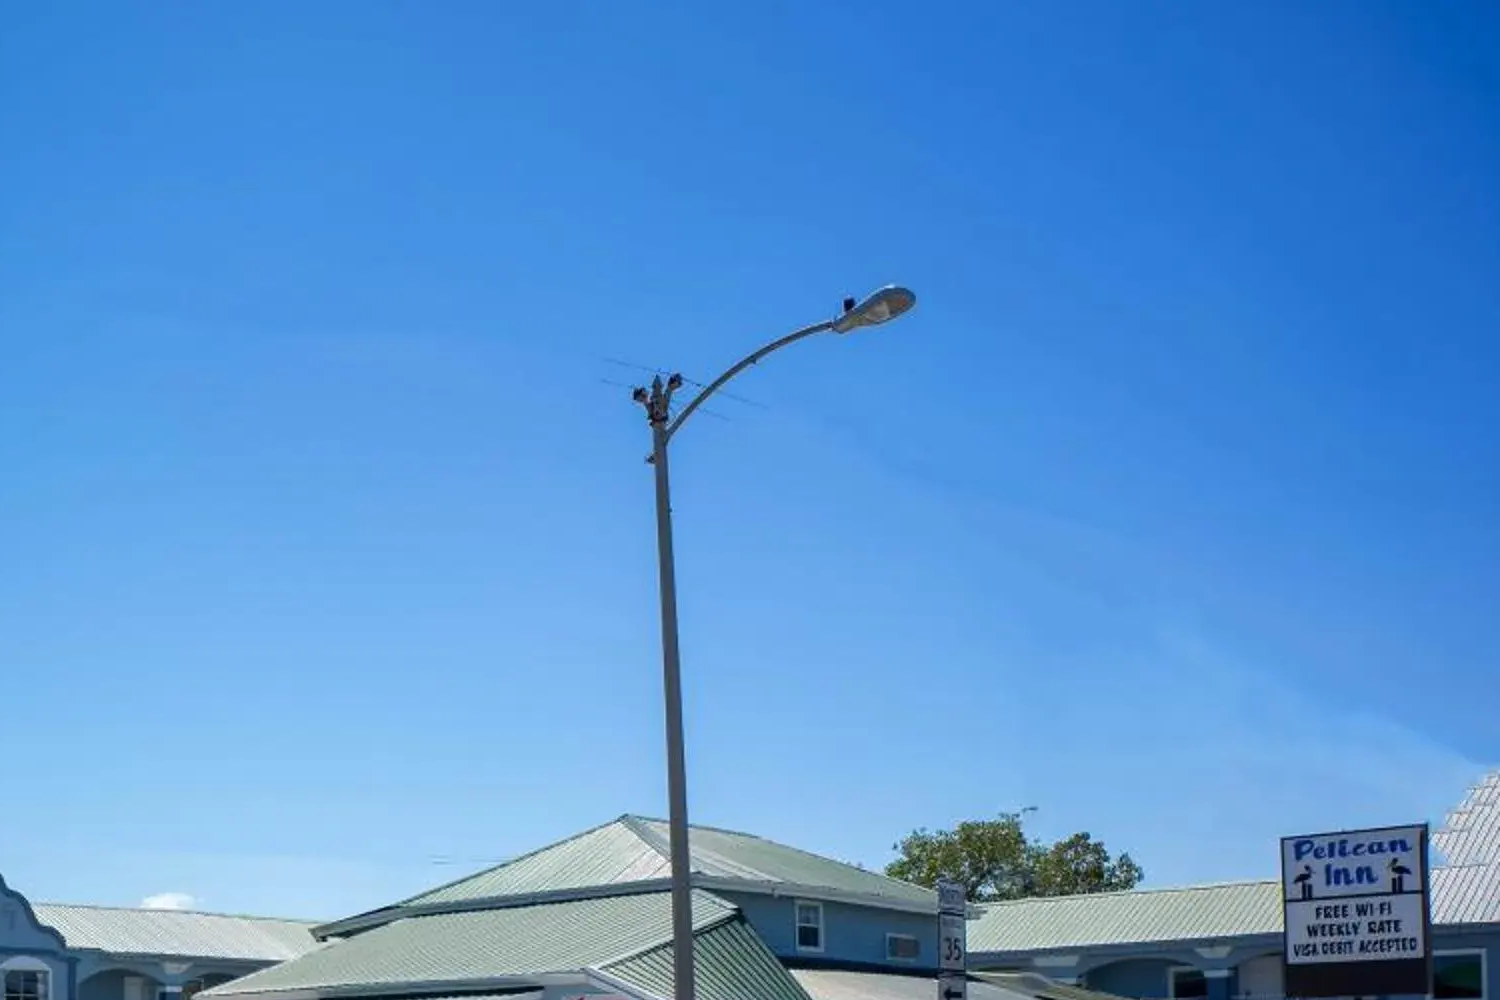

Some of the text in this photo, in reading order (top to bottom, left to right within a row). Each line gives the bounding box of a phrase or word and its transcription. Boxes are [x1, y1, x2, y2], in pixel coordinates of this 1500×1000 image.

[1294, 839, 1412, 861] Pelican
[1324, 863, 1379, 886] Inn
[1315, 904, 1349, 920] FREE
[1306, 919, 1402, 937] WEEKLY RATE
[943, 937, 962, 960] 35
[1359, 937, 1418, 953] ACCEPTED
